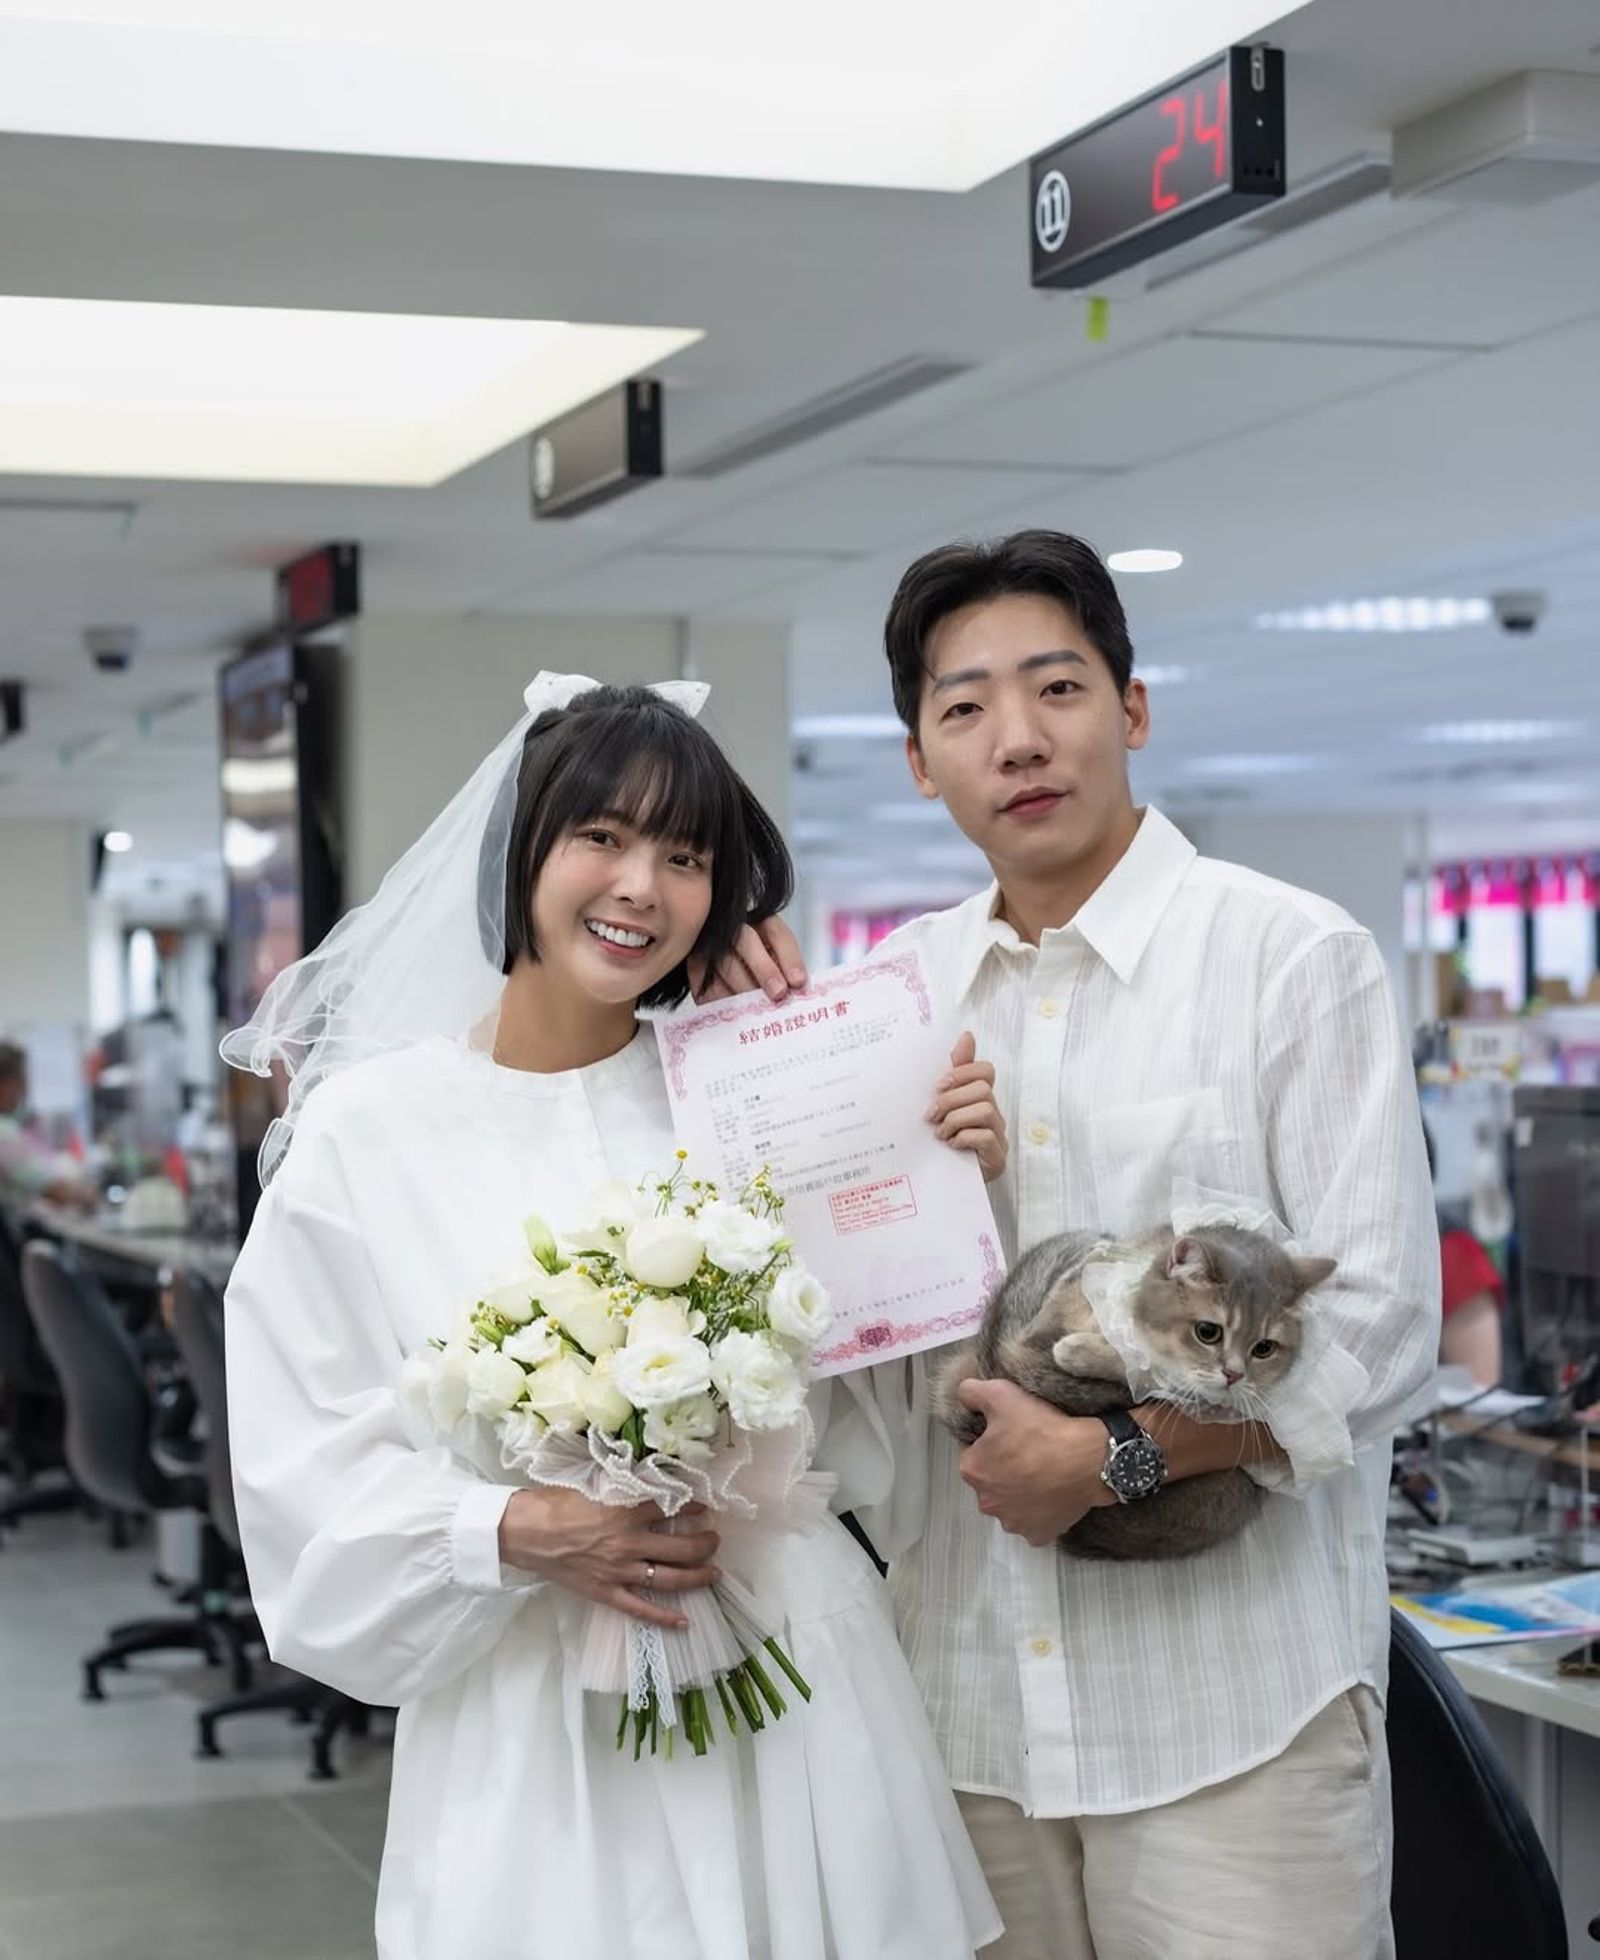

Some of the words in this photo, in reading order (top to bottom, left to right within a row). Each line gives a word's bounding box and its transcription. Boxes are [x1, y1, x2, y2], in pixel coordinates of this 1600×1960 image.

[1152, 80, 1228, 211] 24
[1037, 181, 1068, 239] 11
[739, 1001, 850, 1045] 結婚證明書
